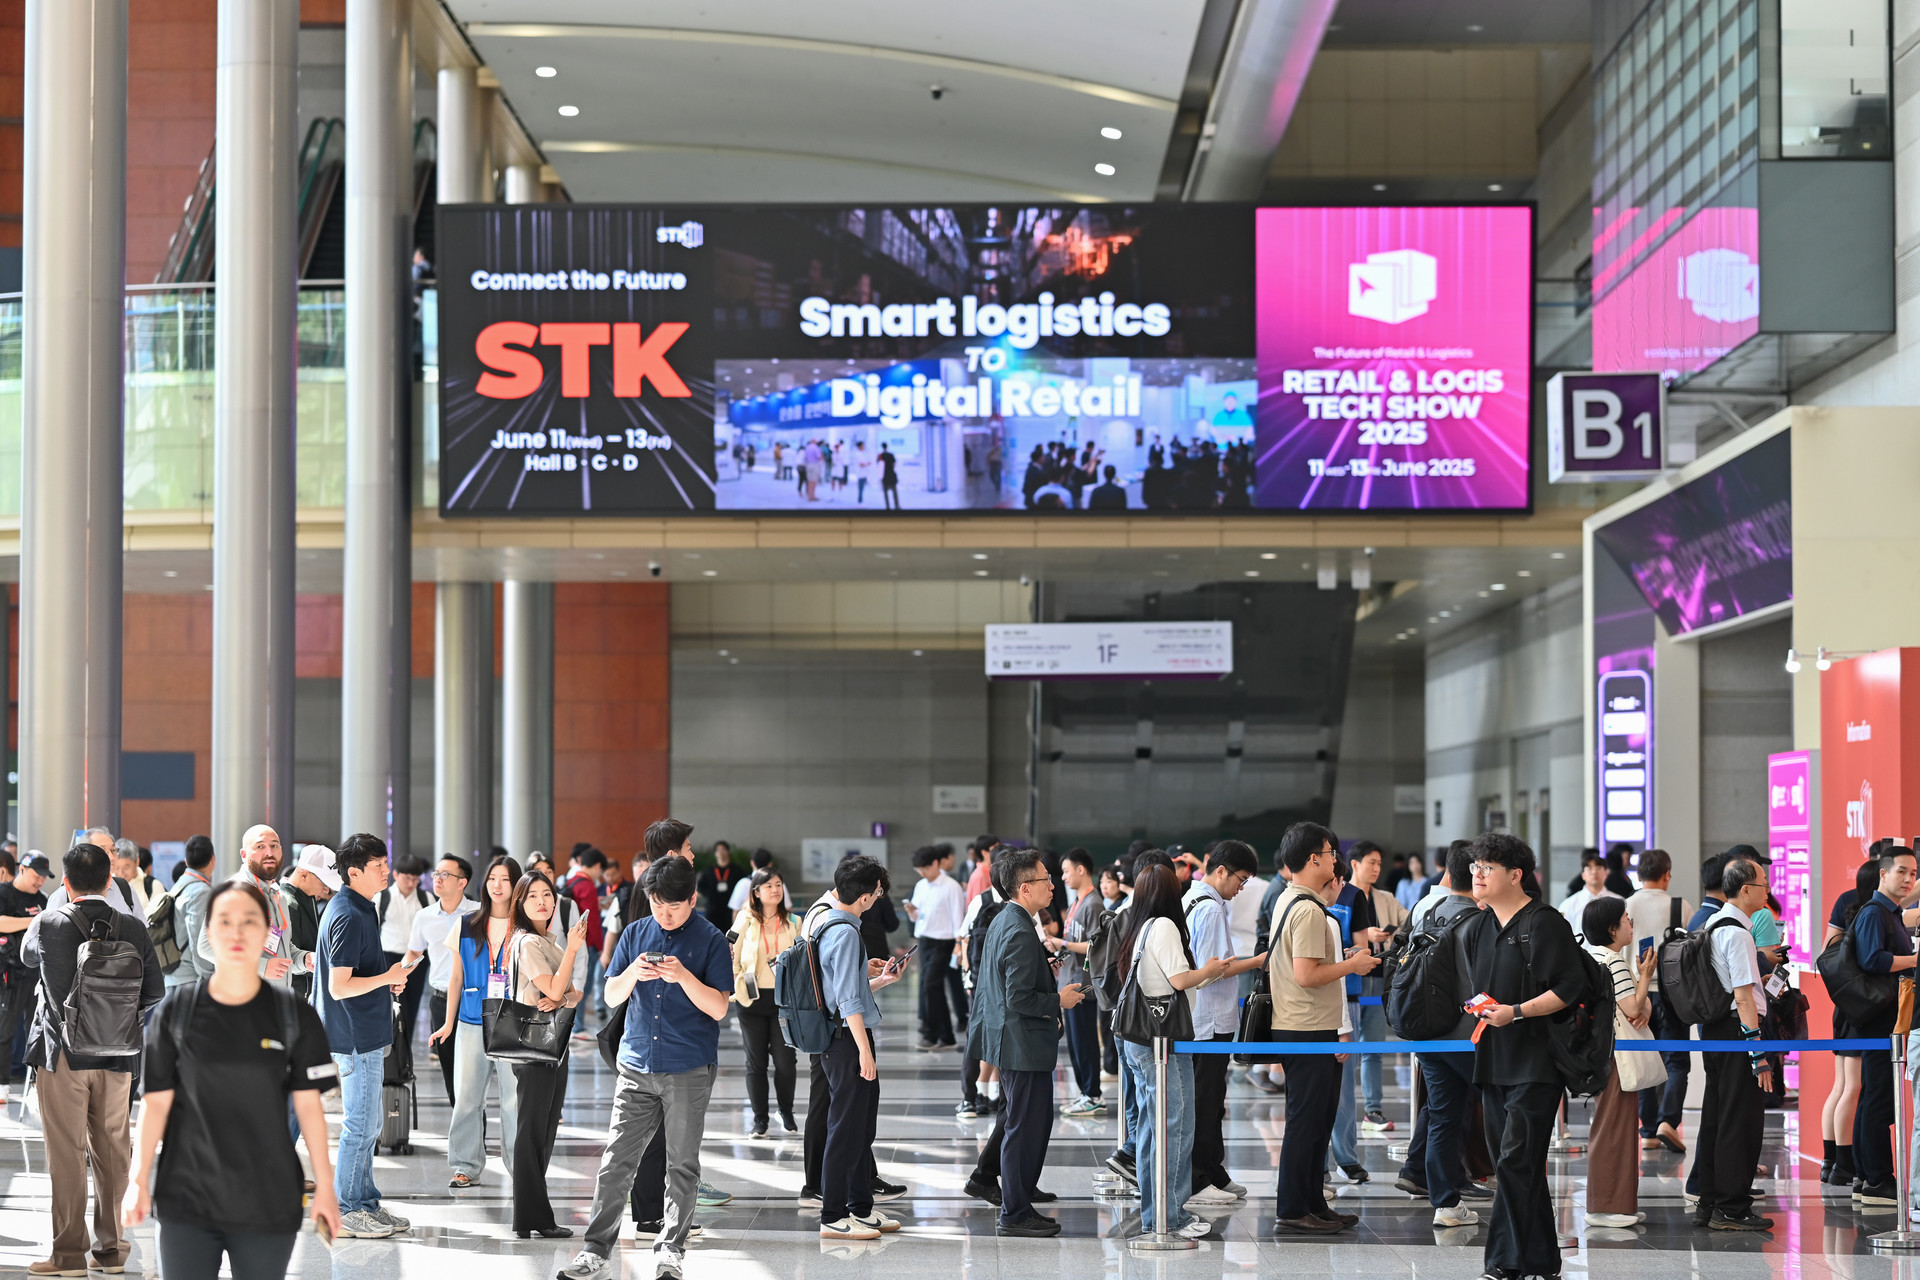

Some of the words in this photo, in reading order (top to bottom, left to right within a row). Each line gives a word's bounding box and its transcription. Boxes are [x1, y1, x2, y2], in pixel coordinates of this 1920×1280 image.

[471, 270, 568, 290] Connect
[571, 270, 609, 290] the
[612, 270, 687, 290] Future
[799, 296, 957, 337] Smart
[963, 292, 1171, 349] logistics
[475, 321, 692, 400] STK
[965, 348, 1006, 373] TO
[1313, 347, 1335, 359] The
[1336, 347, 1372, 359] Future
[1372, 347, 1384, 359] of
[1283, 369, 1384, 394] RETAIL
[1389, 369, 1411, 394] &
[1417, 369, 1504, 394] LOGIS
[831, 373, 992, 429] Digital
[1000, 375, 1141, 418] Retail
[1302, 395, 1381, 419] TECH
[1386, 395, 1483, 419] SHOW
[490, 429, 547, 449] June
[1358, 421, 1428, 445] 2025
[525, 454, 561, 471] Hall
[564, 454, 577, 471] B
[591, 454, 608, 471] C
[623, 454, 639, 471] D
[1381, 459, 1427, 476] June
[1428, 459, 1476, 476] 2025
[1097, 644, 1119, 664] 1F
[1846, 720, 1871, 742] Information
[1846, 800, 1865, 838] STK
